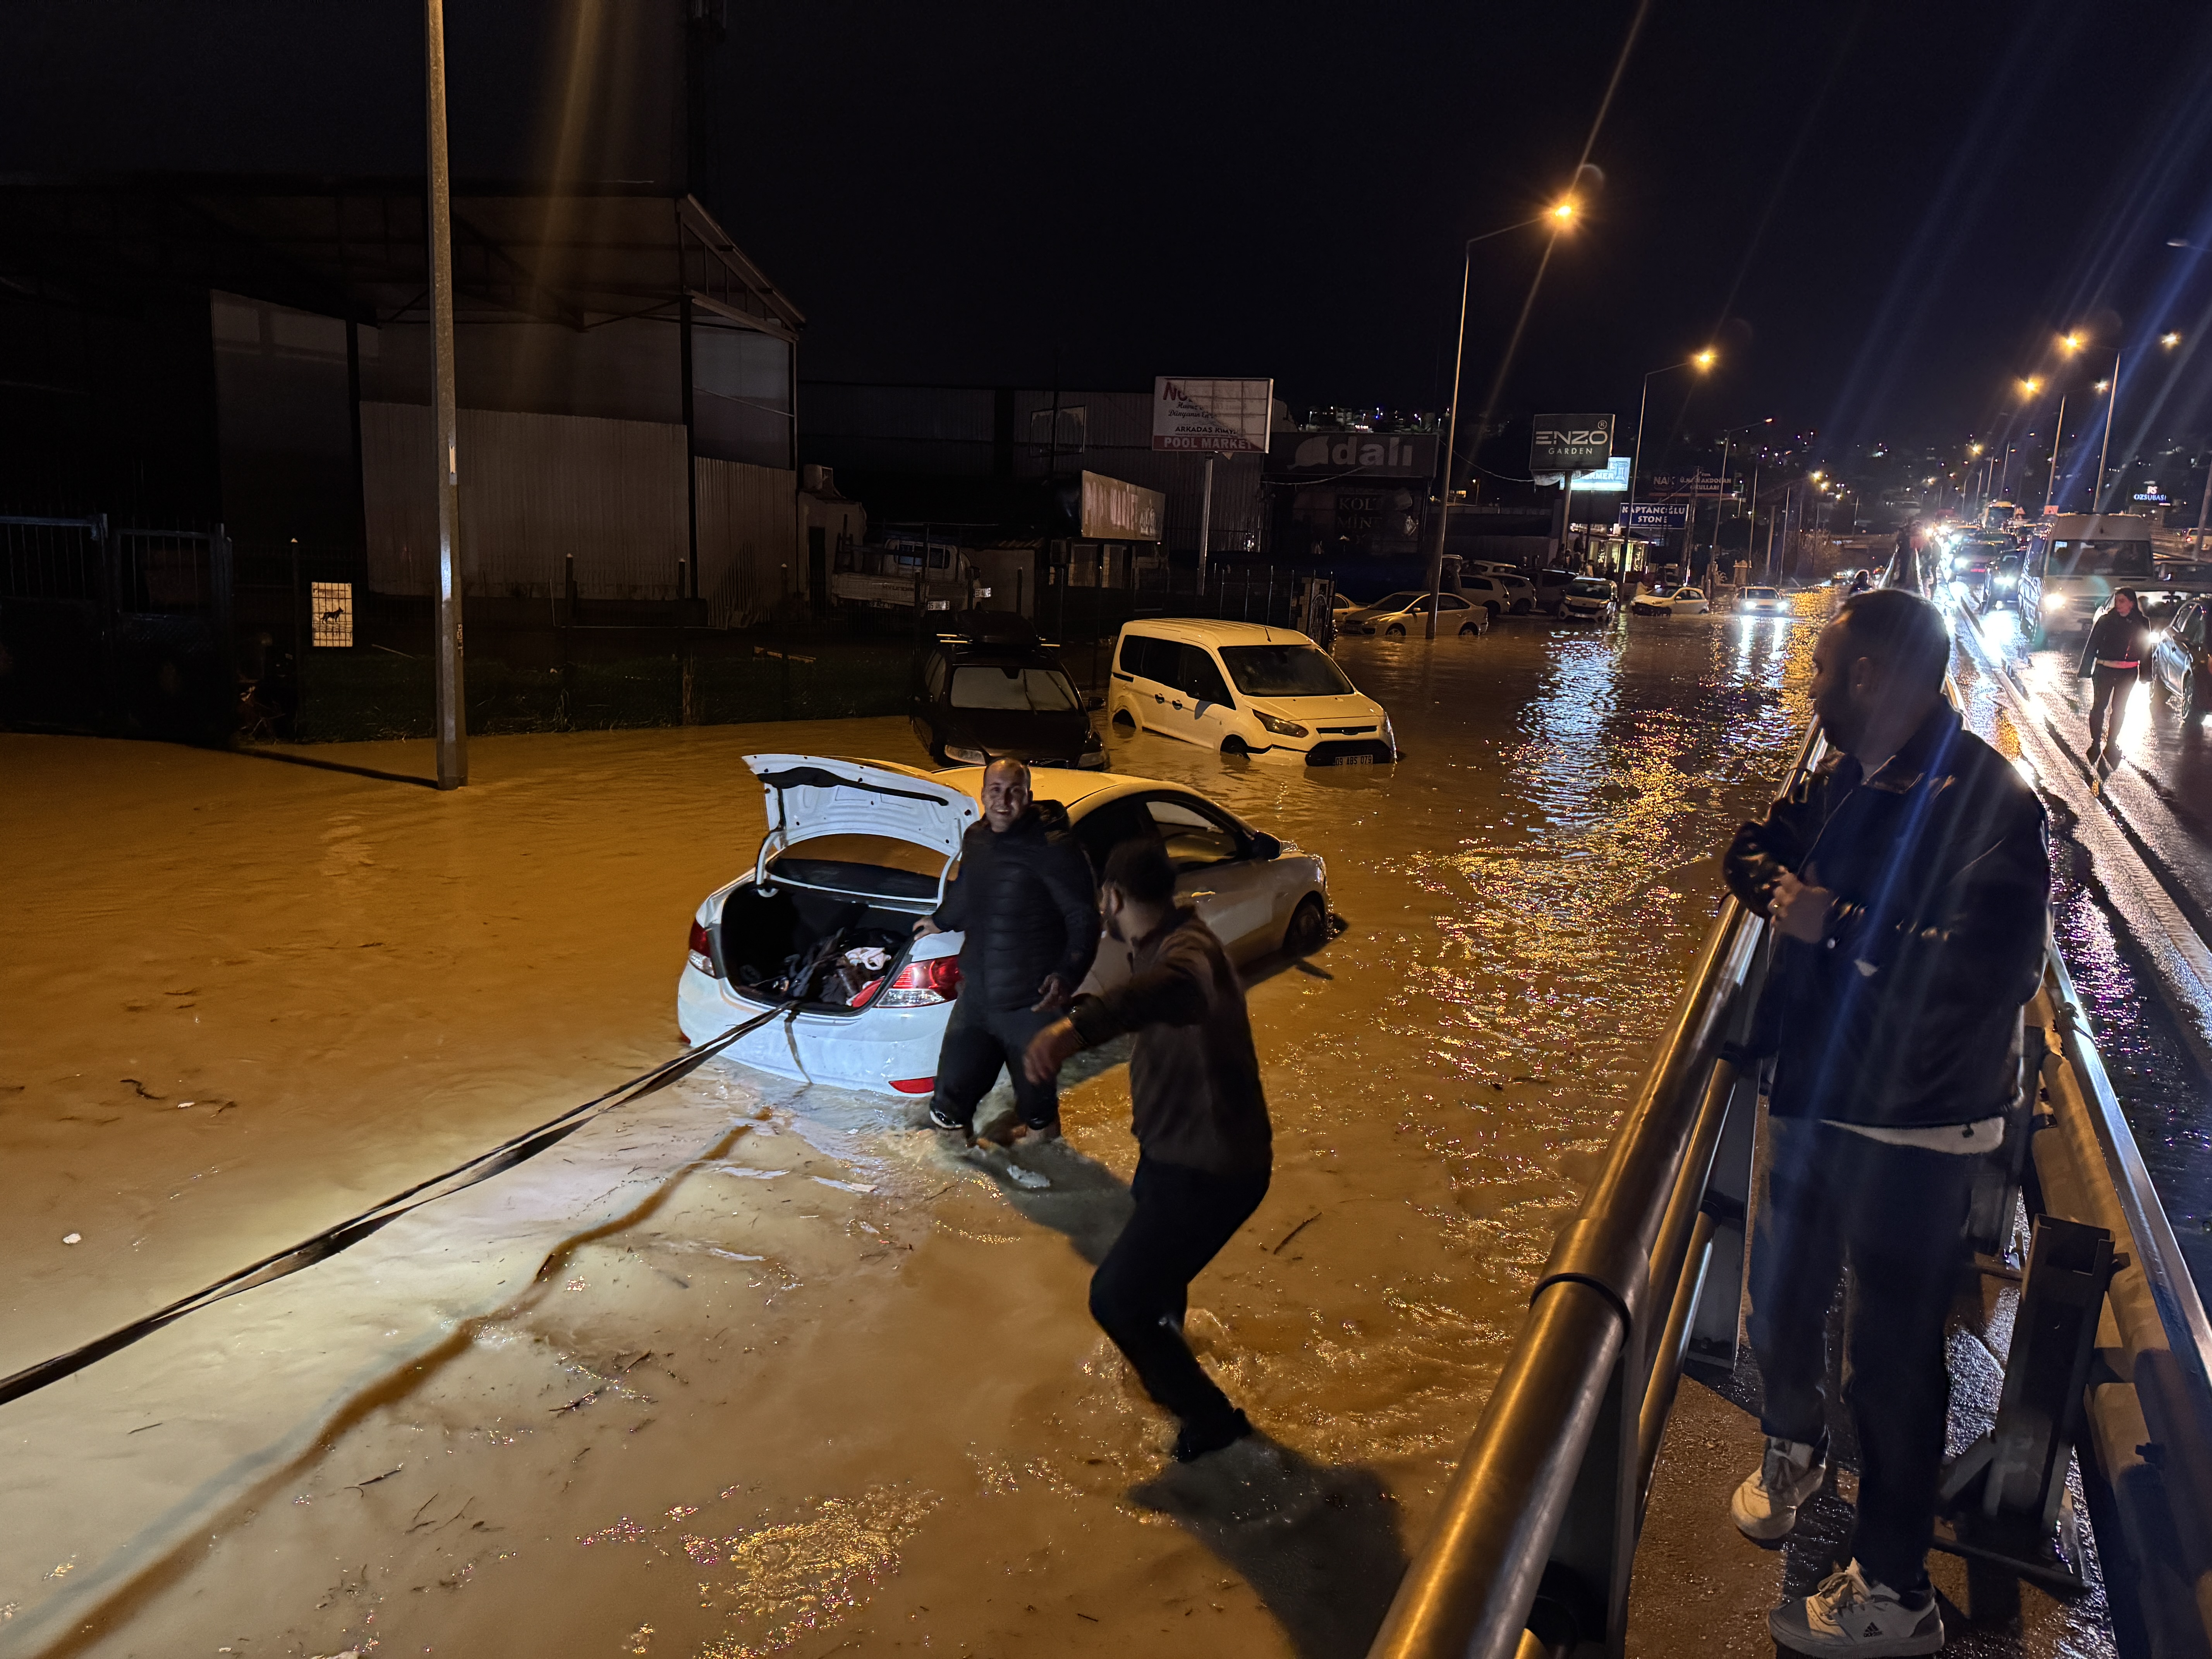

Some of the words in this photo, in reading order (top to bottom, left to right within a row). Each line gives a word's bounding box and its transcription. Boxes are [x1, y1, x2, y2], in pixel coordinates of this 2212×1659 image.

[1164, 437, 1197, 448] POOL
[1201, 438, 1251, 449] MARKET
[1535, 430, 1608, 445] ENZO
[1346, 757, 1357, 765] ABS
[1360, 756, 1372, 764] 079
